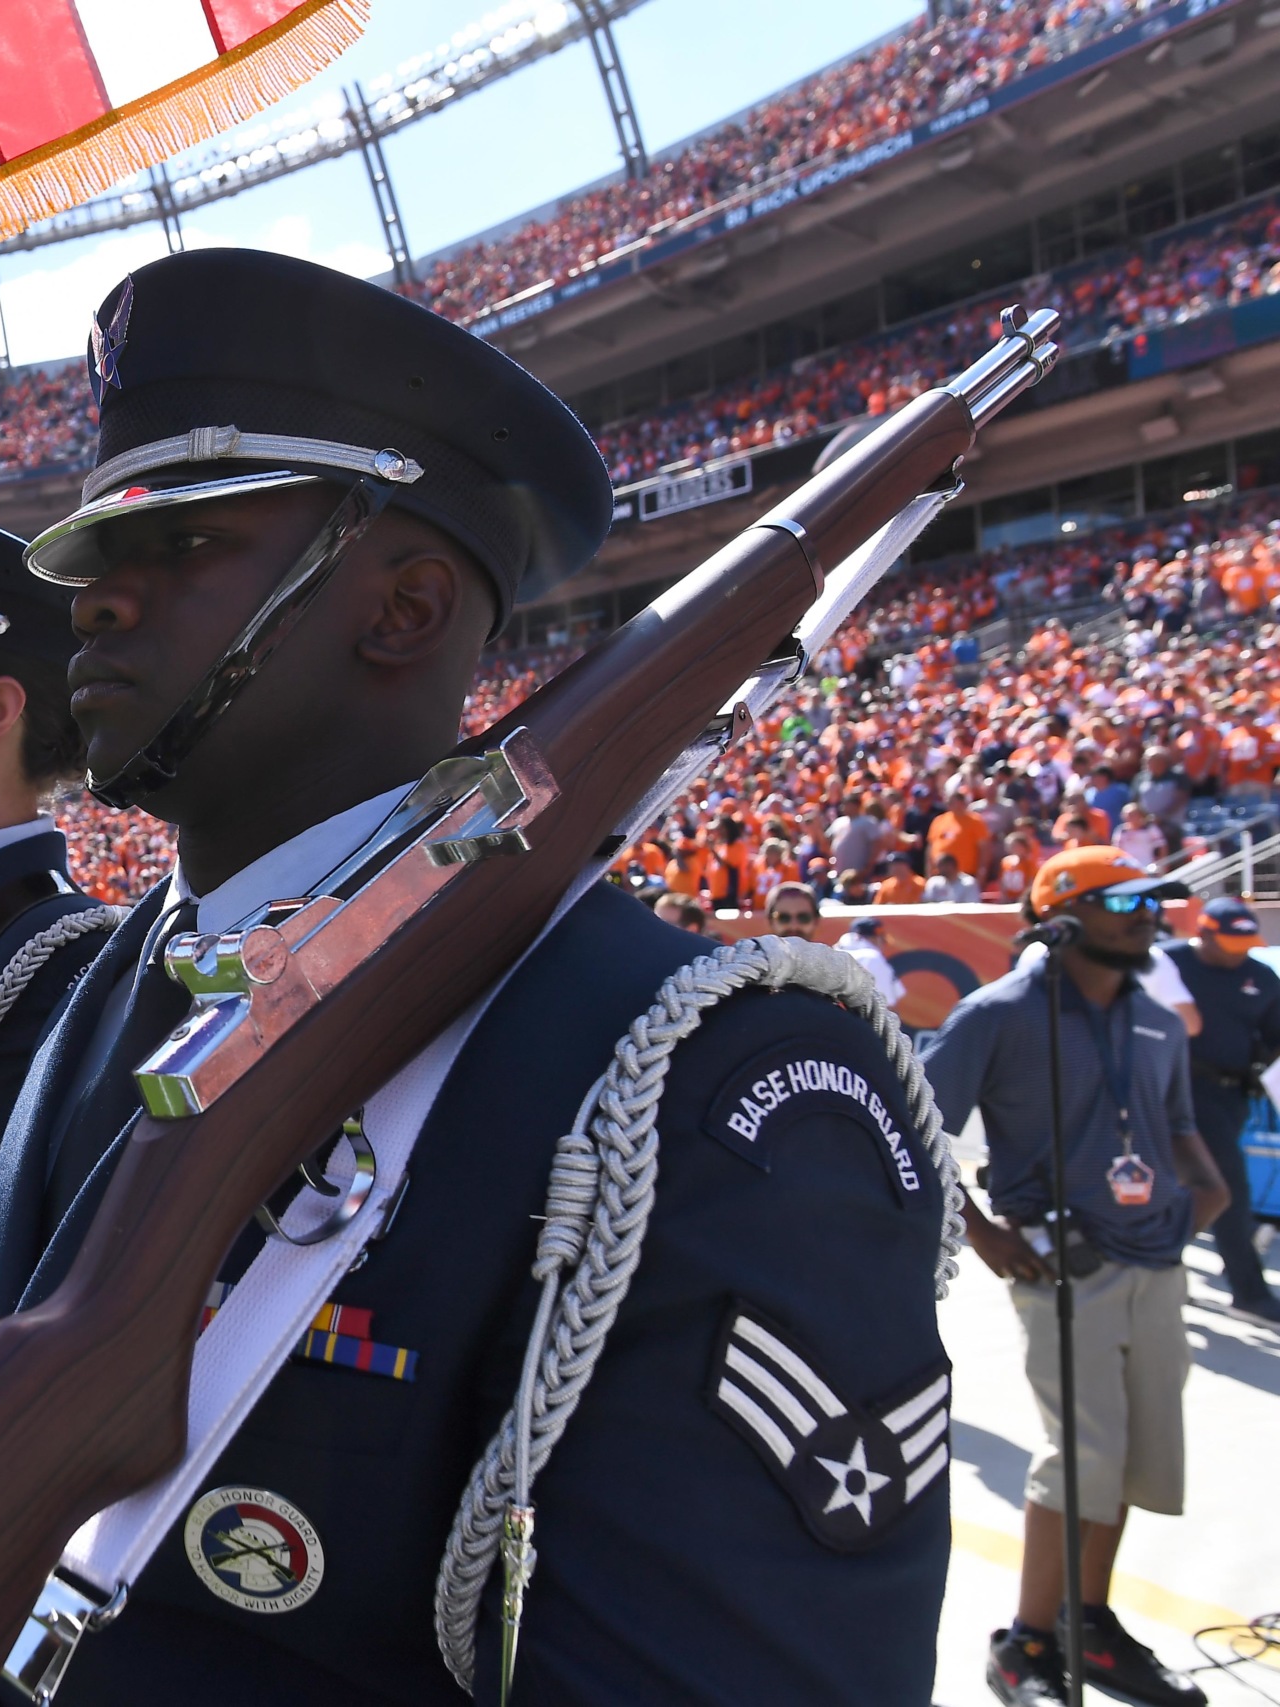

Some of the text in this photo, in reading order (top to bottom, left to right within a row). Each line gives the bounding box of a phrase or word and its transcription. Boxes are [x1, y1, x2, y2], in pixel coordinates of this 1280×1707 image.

[752, 184, 798, 217] RICK
[799, 130, 914, 196] UPCHURCH
[499, 292, 555, 327] REEVES
[726, 1059, 920, 1192] BASE HONOR GUARD
[192, 1490, 317, 1546] BASE HONOR GUARD
[191, 1544, 321, 1611] TO HONOR WITH DIGNITY
